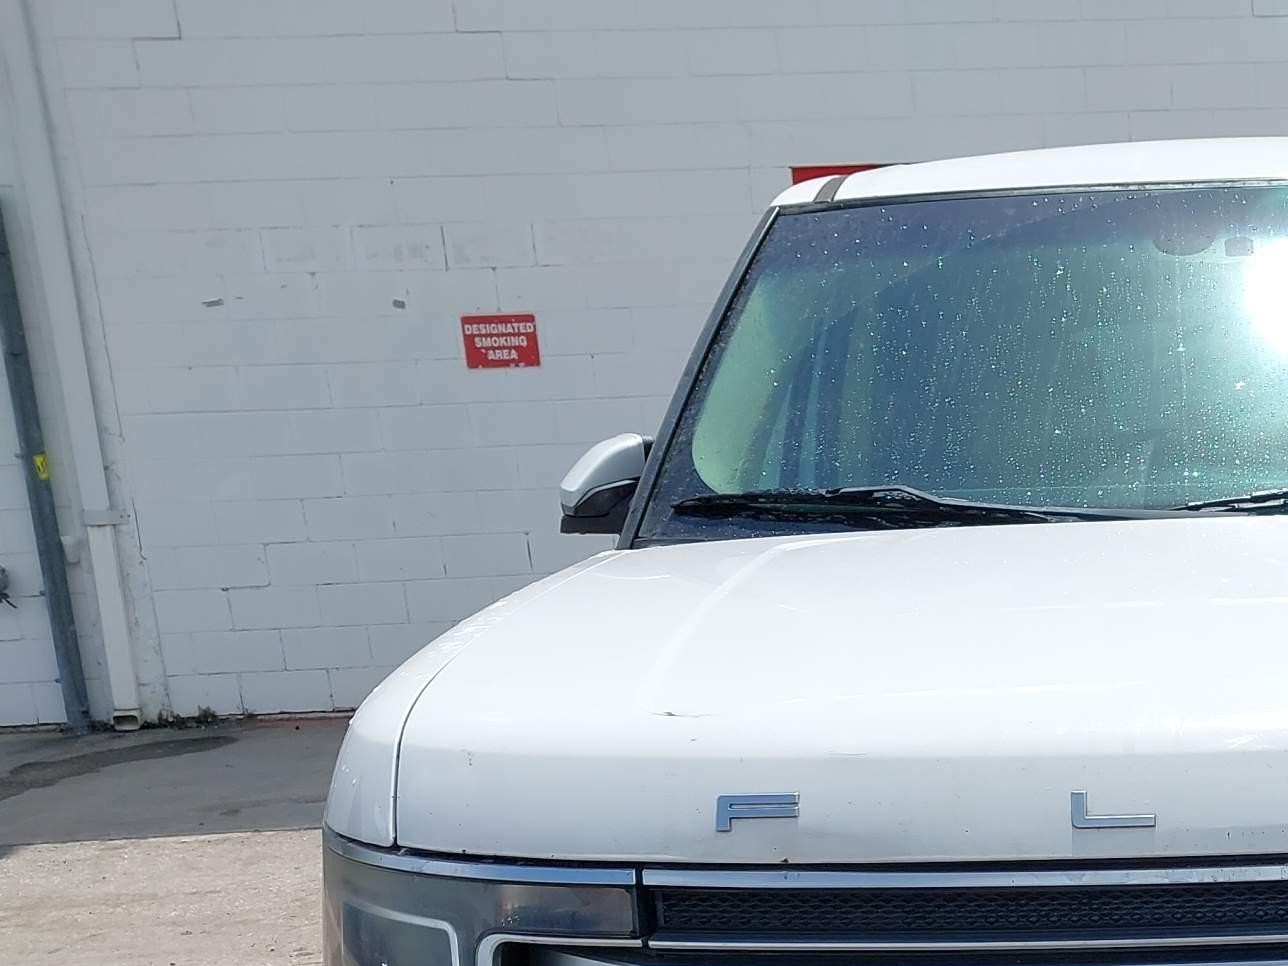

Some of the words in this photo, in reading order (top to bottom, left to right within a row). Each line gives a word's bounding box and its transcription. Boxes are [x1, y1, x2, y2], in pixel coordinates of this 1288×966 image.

[464, 322, 534, 335] DESIGNATED
[474, 335, 528, 348] SMOKING
[486, 348, 519, 361] AREA
